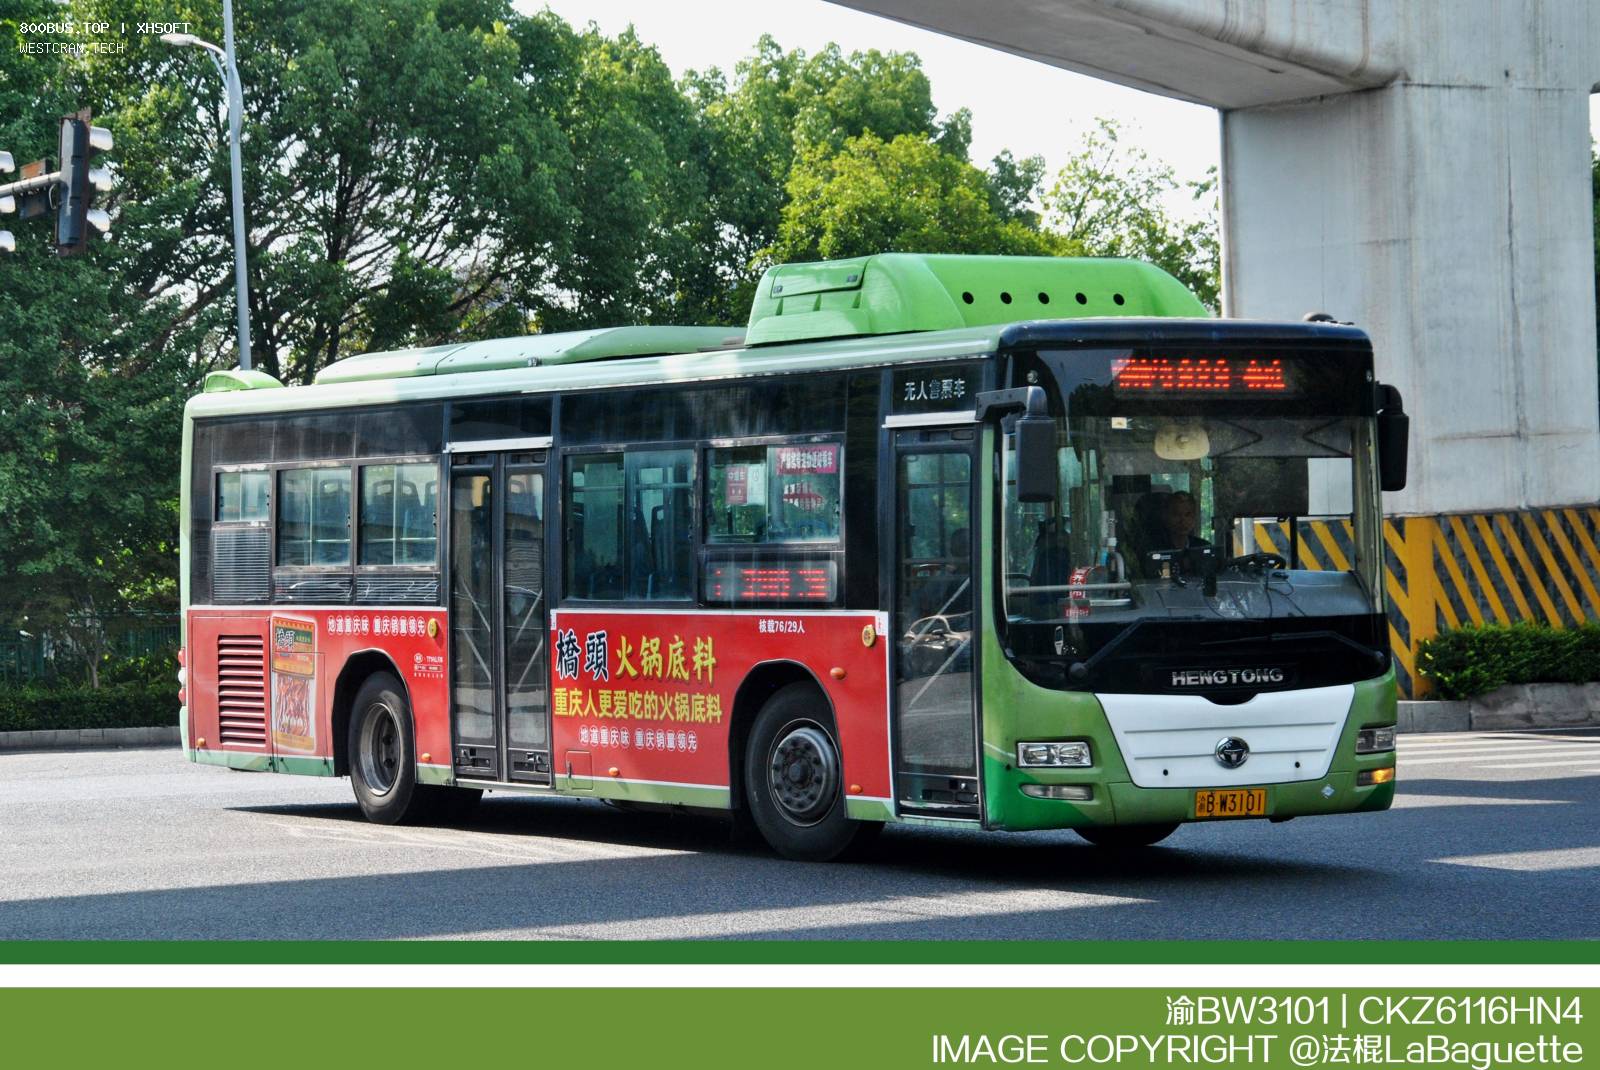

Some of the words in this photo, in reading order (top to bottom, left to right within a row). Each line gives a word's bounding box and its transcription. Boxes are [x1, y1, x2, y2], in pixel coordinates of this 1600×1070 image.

[904, 378, 966, 401] 无人售票车
[327, 615, 370, 636] 地道重庆味
[373, 615, 427, 637] 重庆销量领先
[758, 618, 806, 634] 核载76/29人
[555, 628, 610, 682] 橋頭
[615, 635, 717, 683] 火锅底料
[1171, 668, 1284, 686] HENGTONG
[553, 687, 723, 724] 重庆人更爱吃的火锅底料
[579, 726, 631, 749] 地道重庆味
[635, 727, 698, 753] 重庆销量领先
